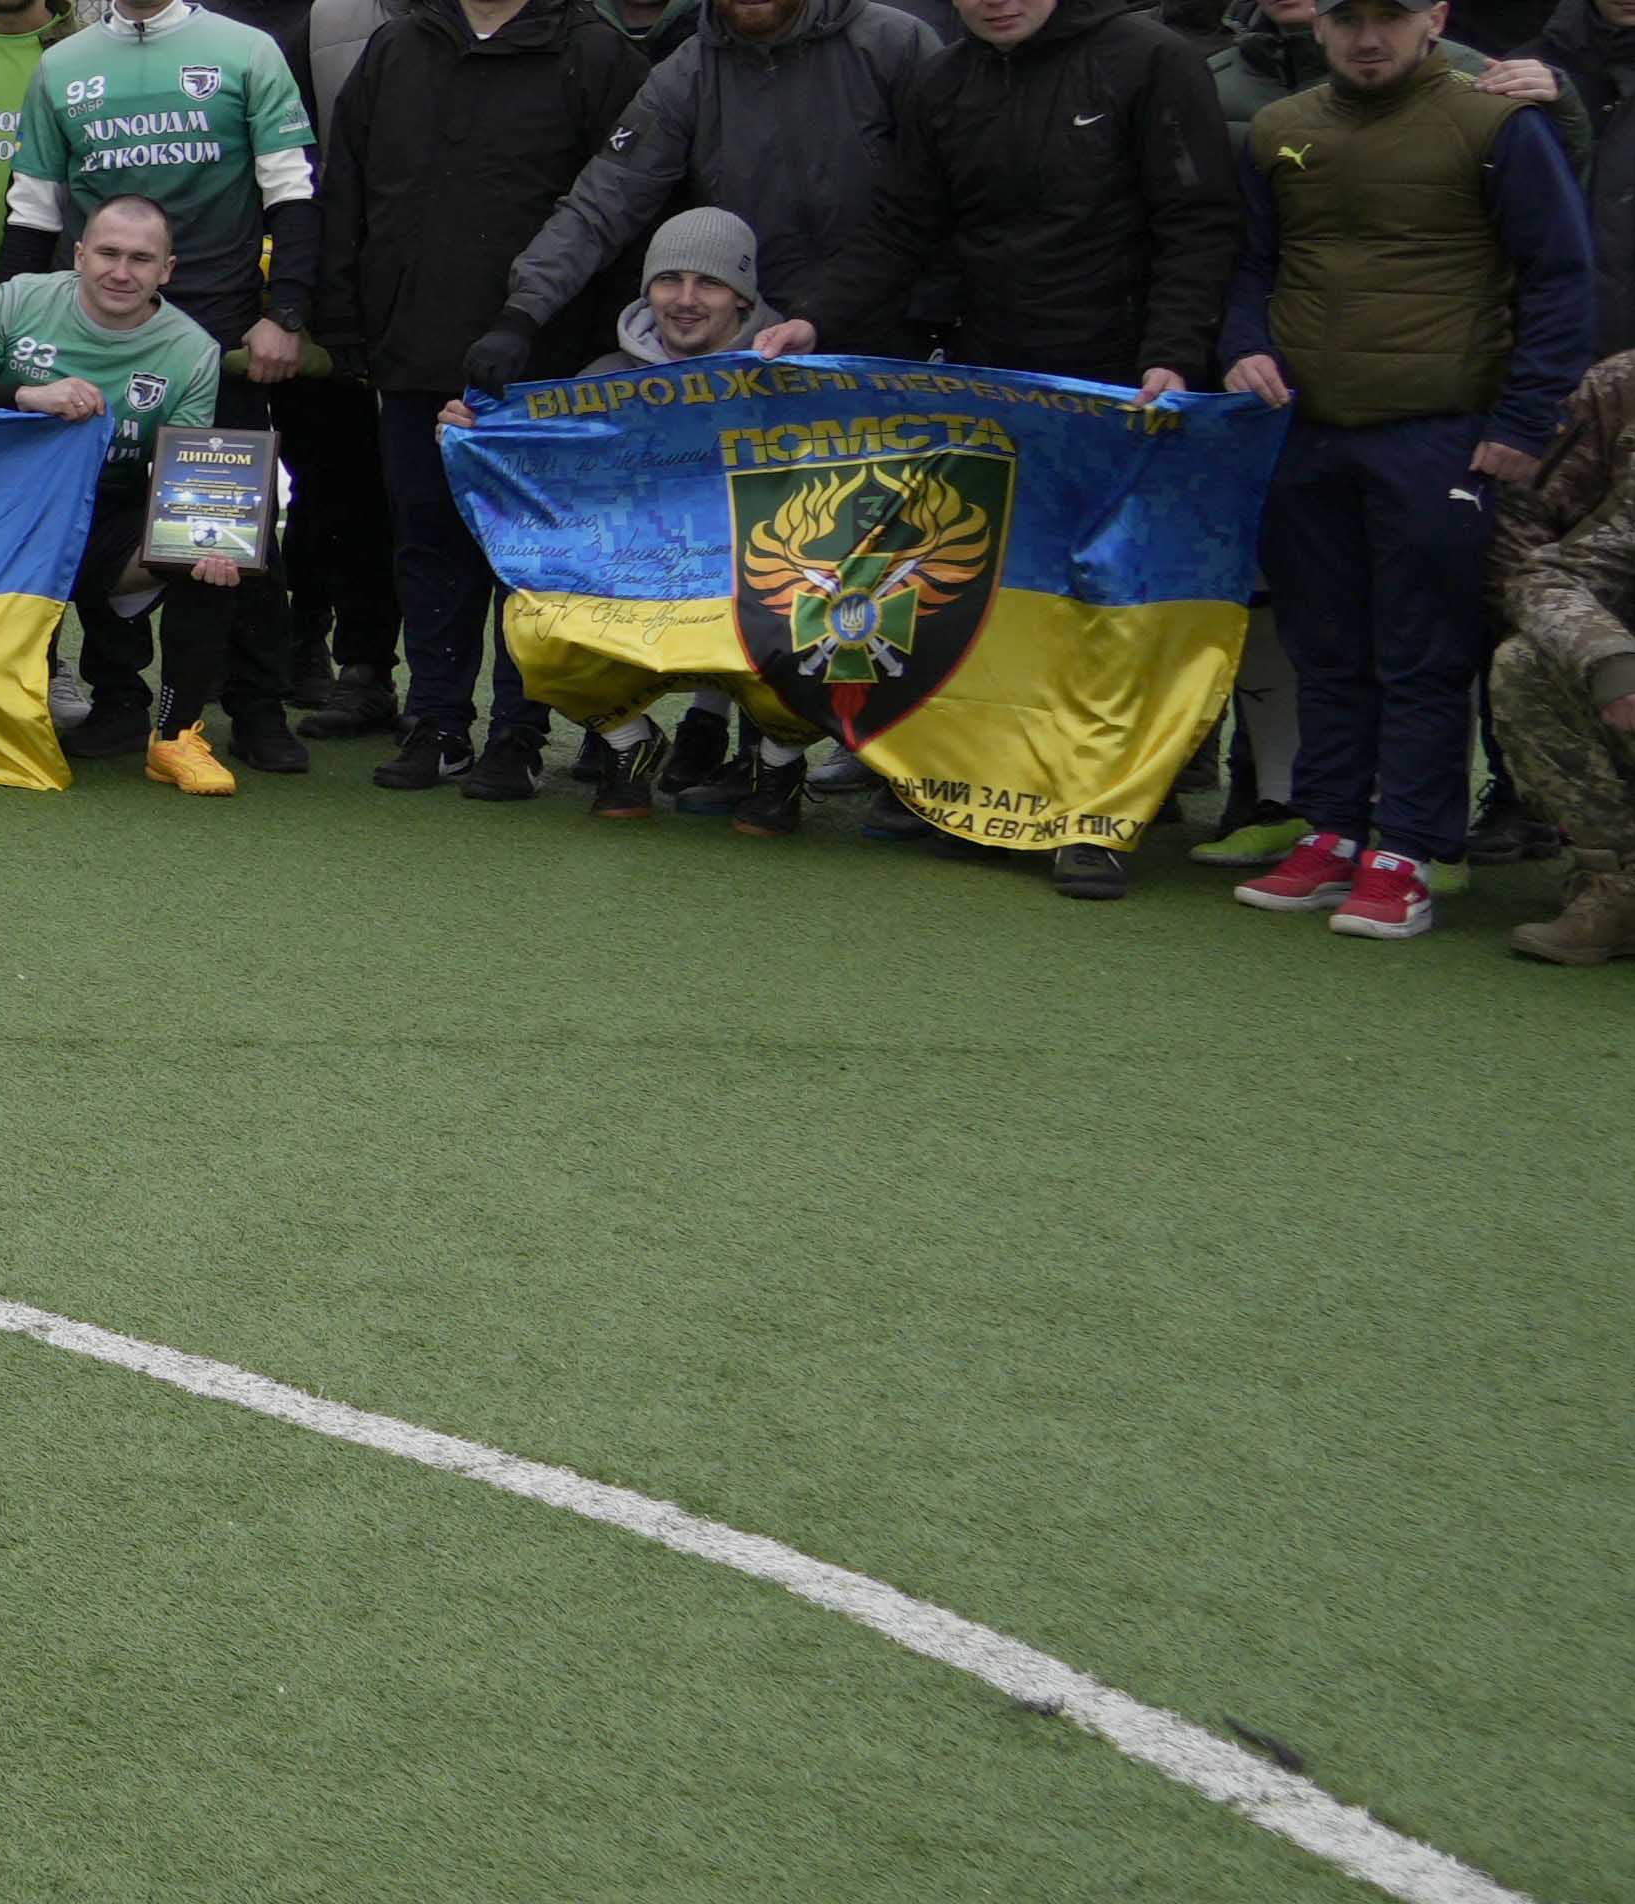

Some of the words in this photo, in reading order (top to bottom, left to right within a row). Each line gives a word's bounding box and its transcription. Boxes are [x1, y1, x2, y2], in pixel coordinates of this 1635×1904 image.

[66, 76, 105, 105] 93
[13, 336, 57, 369] 93
[9, 358, 51, 380] ОМБР
[526, 366, 853, 421] ВІДРОДЖЕНІ
[719, 413, 1018, 468] ПОМСТА
[176, 450, 253, 465] ДИПЛОМ
